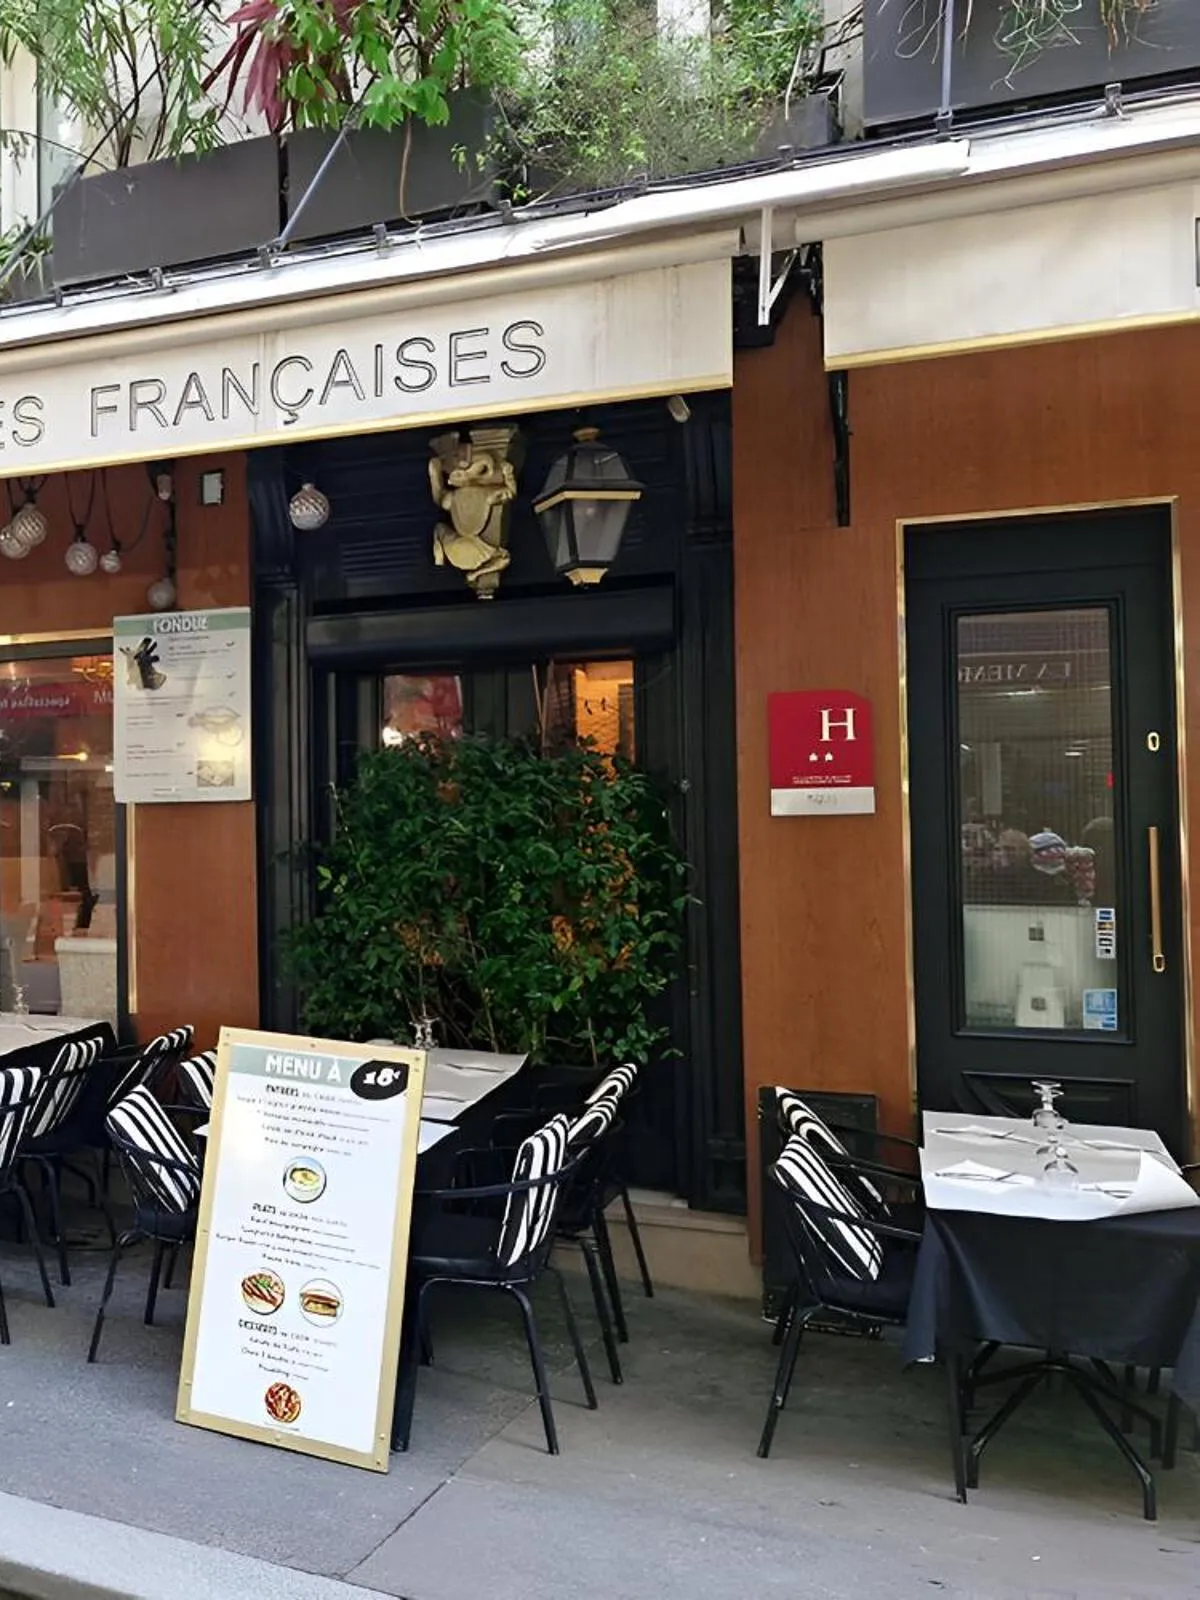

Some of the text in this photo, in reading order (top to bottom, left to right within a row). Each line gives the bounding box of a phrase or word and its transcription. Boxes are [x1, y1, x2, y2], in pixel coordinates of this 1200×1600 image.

[90, 320, 547, 437] FRANÇAISES
[819, 707, 857, 742] H
[265, 1053, 323, 1081] MENU
[327, 1061, 342, 1083] À
